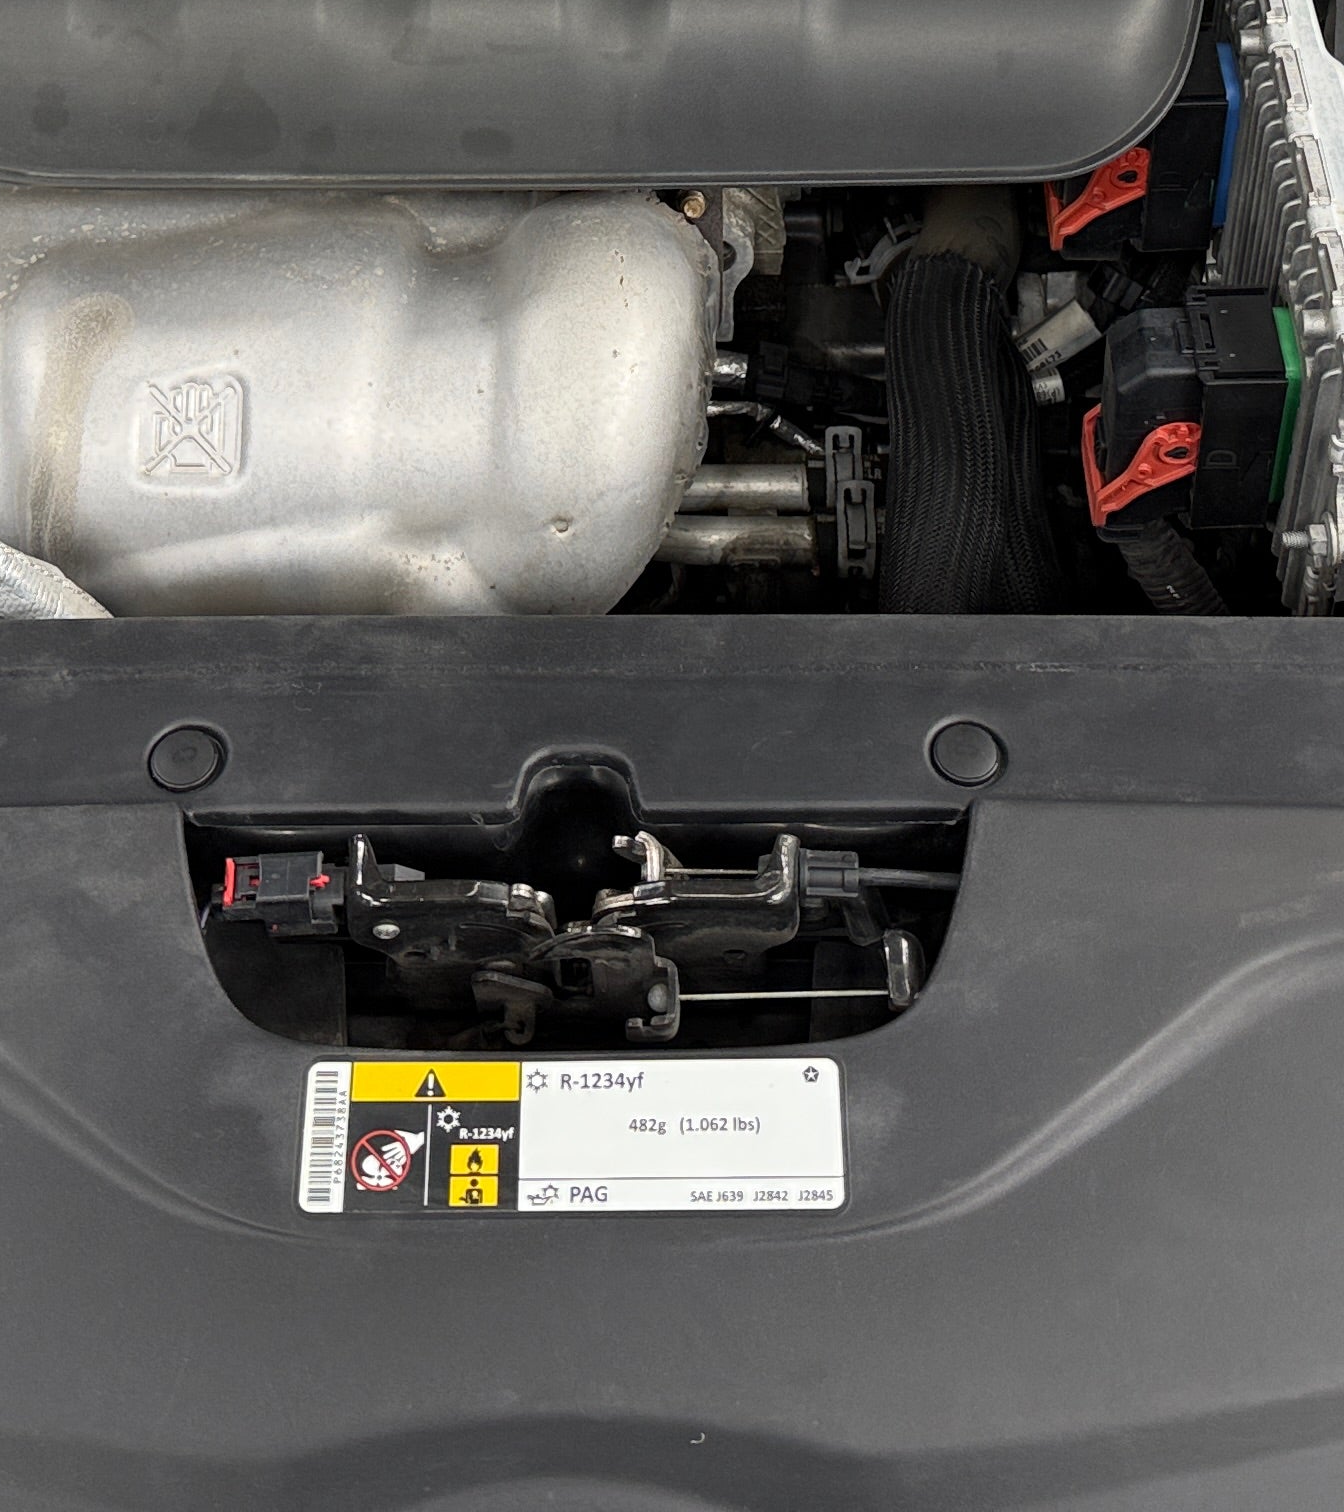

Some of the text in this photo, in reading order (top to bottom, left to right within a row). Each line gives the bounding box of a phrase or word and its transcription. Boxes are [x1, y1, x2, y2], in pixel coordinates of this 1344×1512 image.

[560, 1071, 645, 1092] R-1234yf
[629, 1116, 761, 1135] 482g (1.062 lbs)
[459, 1127, 515, 1142] R-1234yf
[570, 1186, 608, 1203] PAG
[690, 1189, 834, 1203] SAE J639 J2842 J2845
